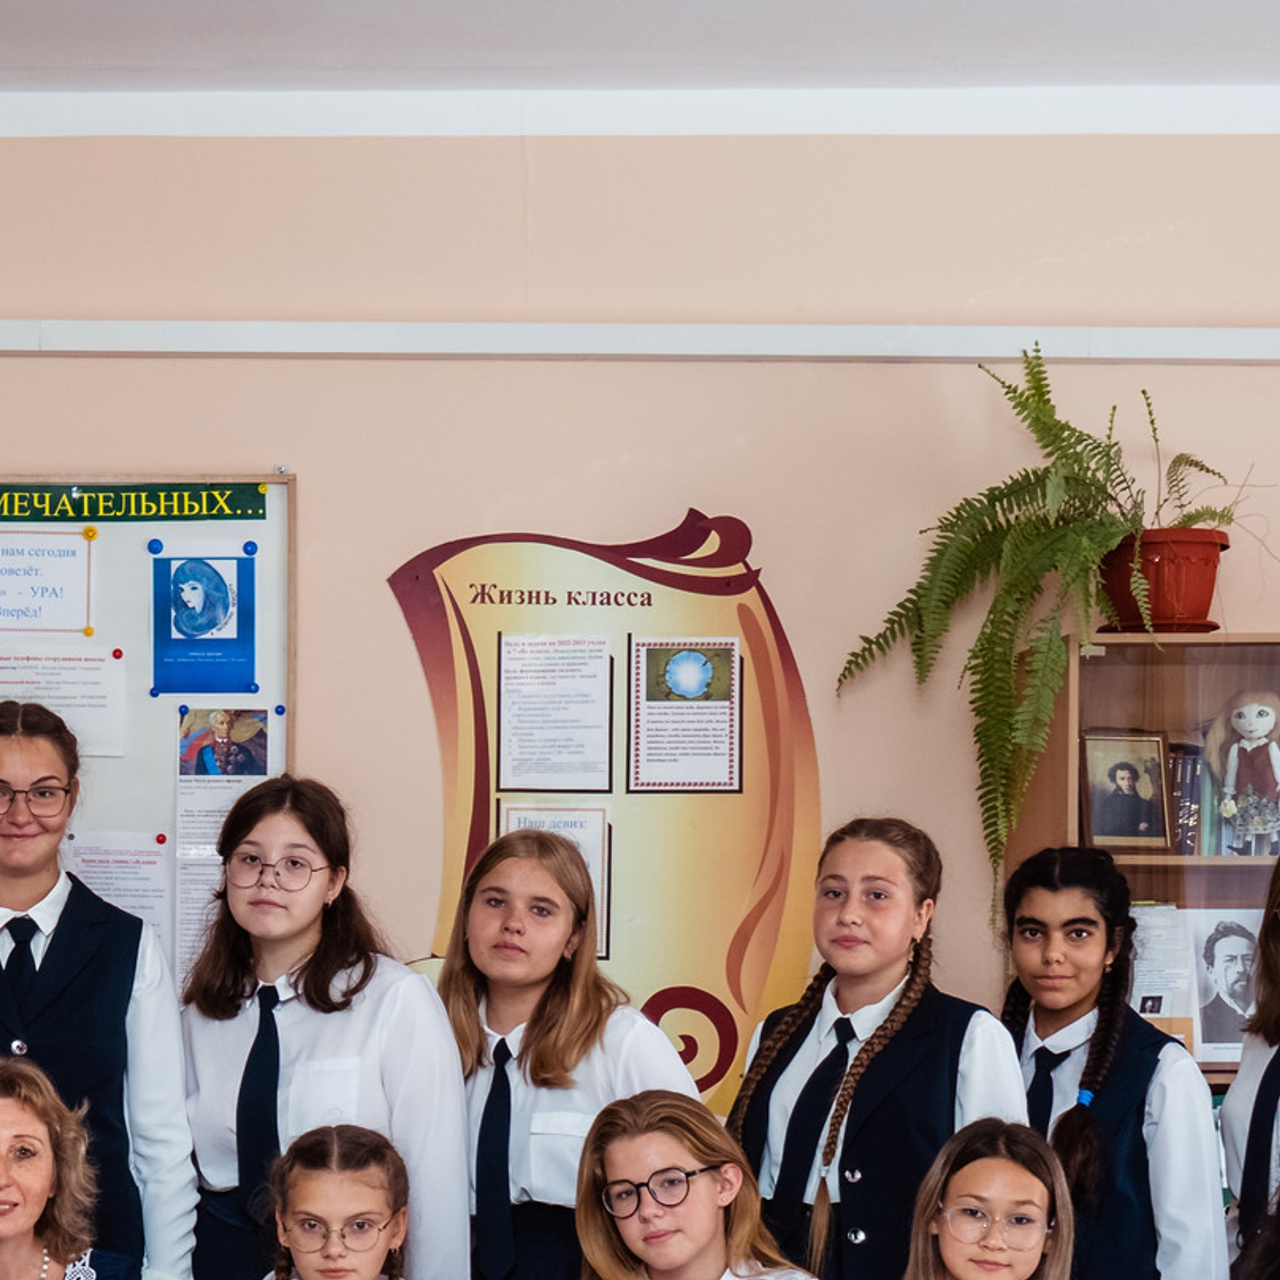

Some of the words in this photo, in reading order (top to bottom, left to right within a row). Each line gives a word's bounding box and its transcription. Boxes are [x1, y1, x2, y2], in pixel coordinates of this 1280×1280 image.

[1, 547, 24, 556] нам
[28, 548, 77, 558] сегодня
[30, 586, 64, 598] УРА!
[469, 583, 557, 604] Жизнь
[566, 590, 652, 606] класса
[517, 816, 546, 828] Наш
